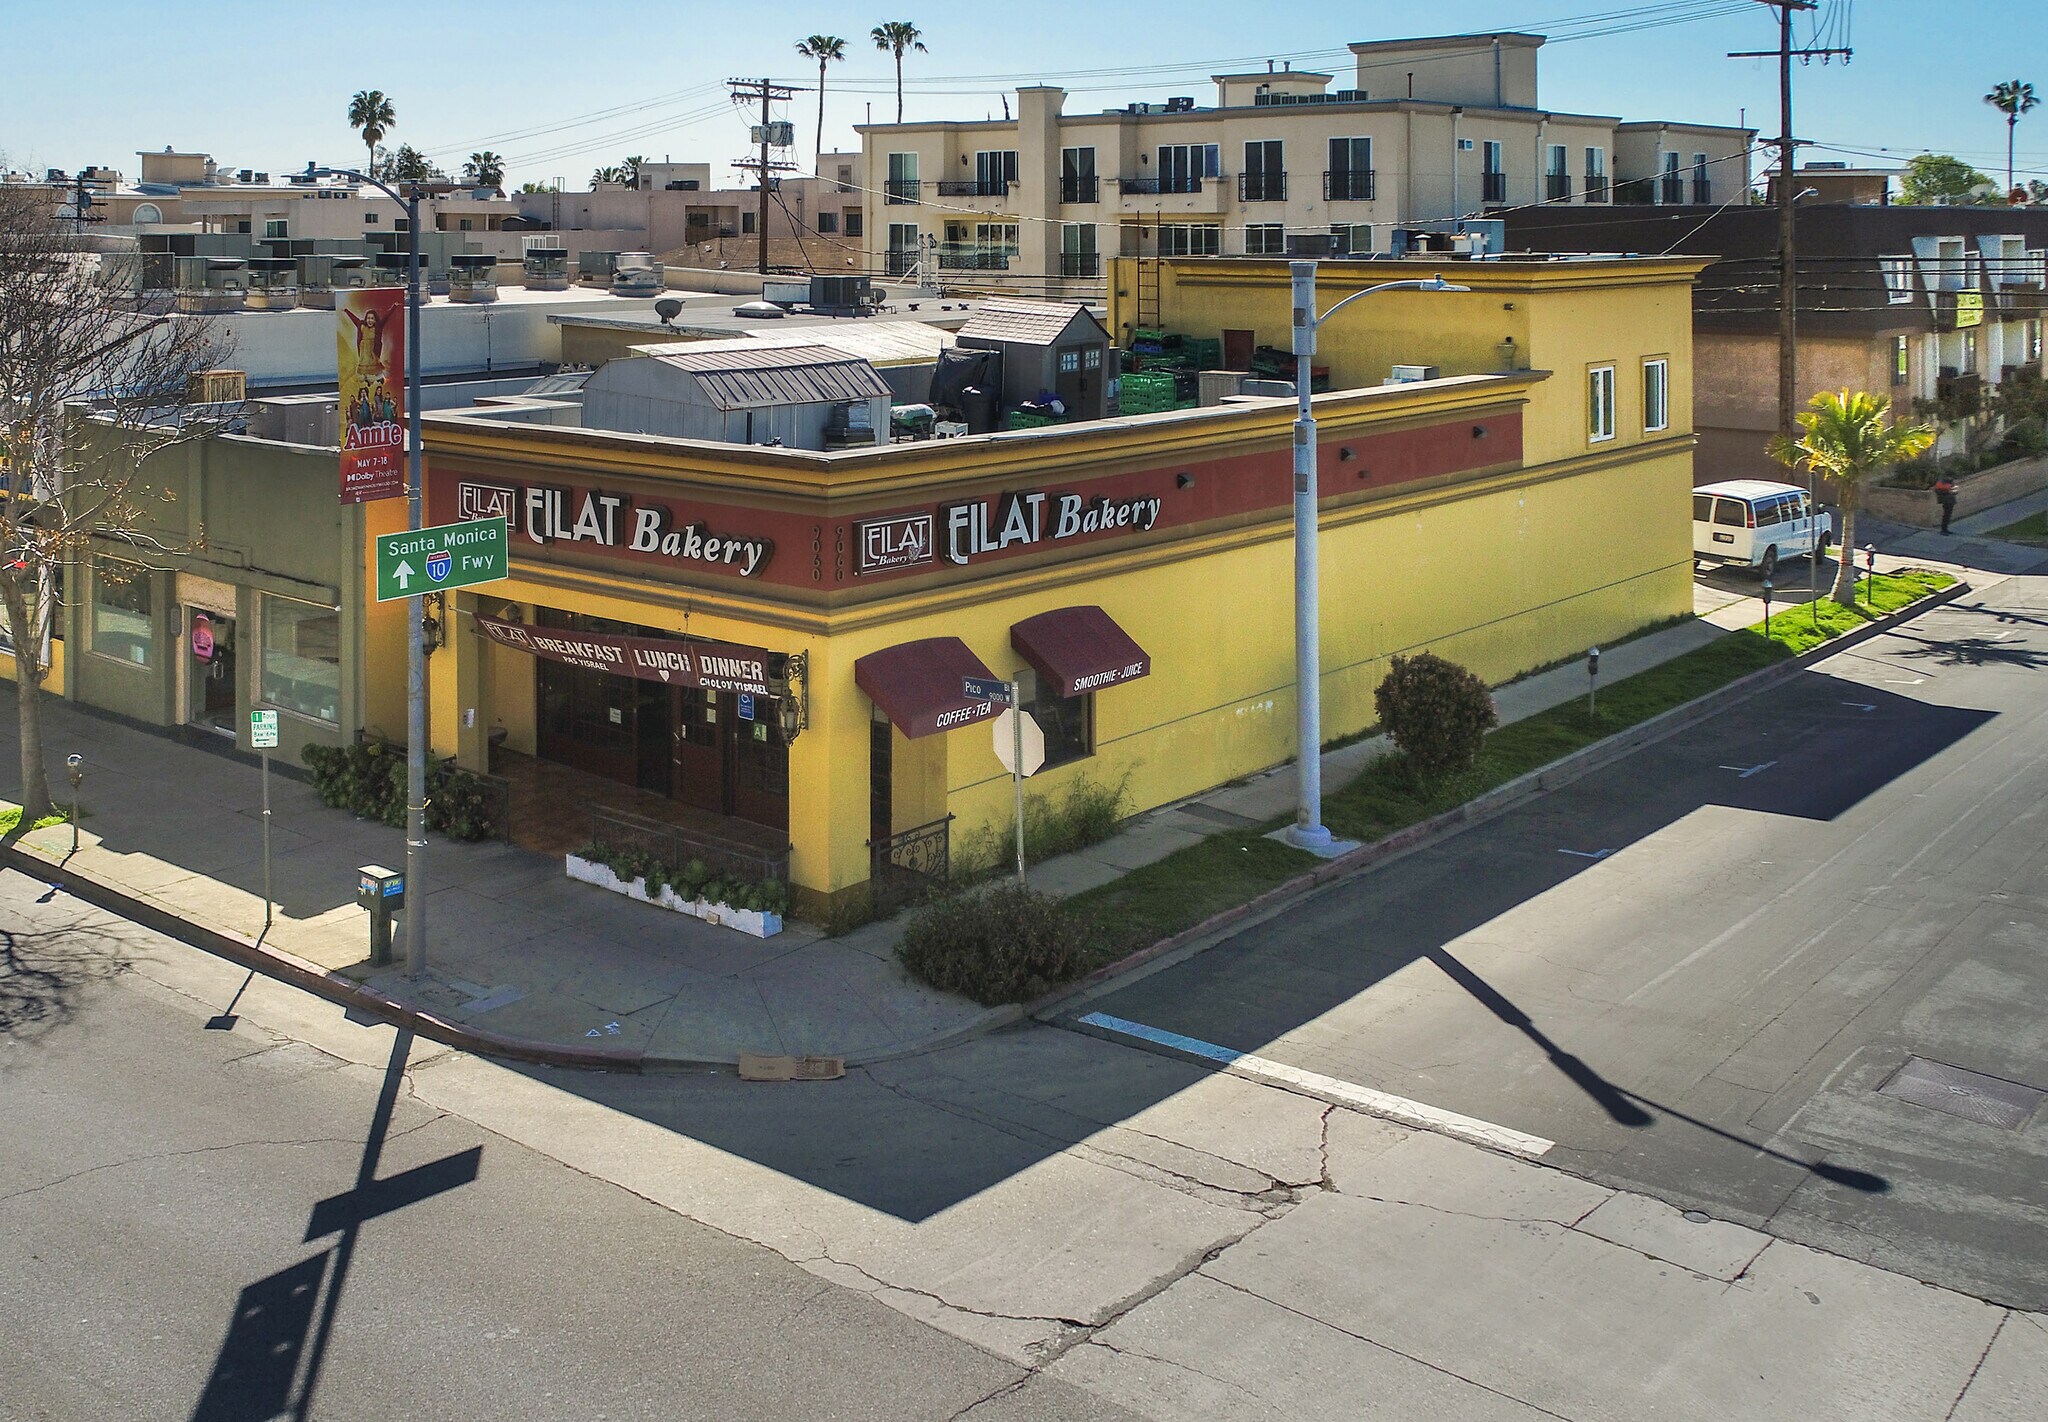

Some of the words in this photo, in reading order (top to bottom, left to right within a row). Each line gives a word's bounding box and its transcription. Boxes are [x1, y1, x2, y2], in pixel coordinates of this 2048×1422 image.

[343, 421, 402, 451] Annie
[356, 459, 371, 468] MAY
[373, 456, 388, 466] 7-18
[356, 472, 374, 481] Dolby
[375, 469, 398, 478] Theatre
[463, 487, 511, 516] EILAT
[388, 537, 435, 556] Santa
[444, 528, 497, 547] Monica
[526, 487, 620, 546] EILAT
[629, 508, 763, 577] Bakery
[868, 521, 927, 560] EILAT
[949, 492, 1046, 565] EILAT
[1054, 494, 1161, 531] Bakery
[432, 562, 446, 578] 10
[462, 554, 494, 571] Fwy
[878, 555, 908, 566] Bakery
[533, 636, 624, 664] BREAKFAST
[634, 649, 692, 672] LUNCH
[700, 655, 764, 681] DINNER
[563, 656, 578, 665] PAS
[579, 658, 610, 671] YISRAEL
[700, 677, 732, 689] CHOLOV
[734, 682, 769, 695] YISRAEL
[1074, 669, 1118, 691] SMOOTHIE
[1121, 661, 1143, 679] JUICE
[988, 692, 1004, 702] 9000
[936, 706, 972, 727] COFFEE
[976, 701, 991, 716] TEA
